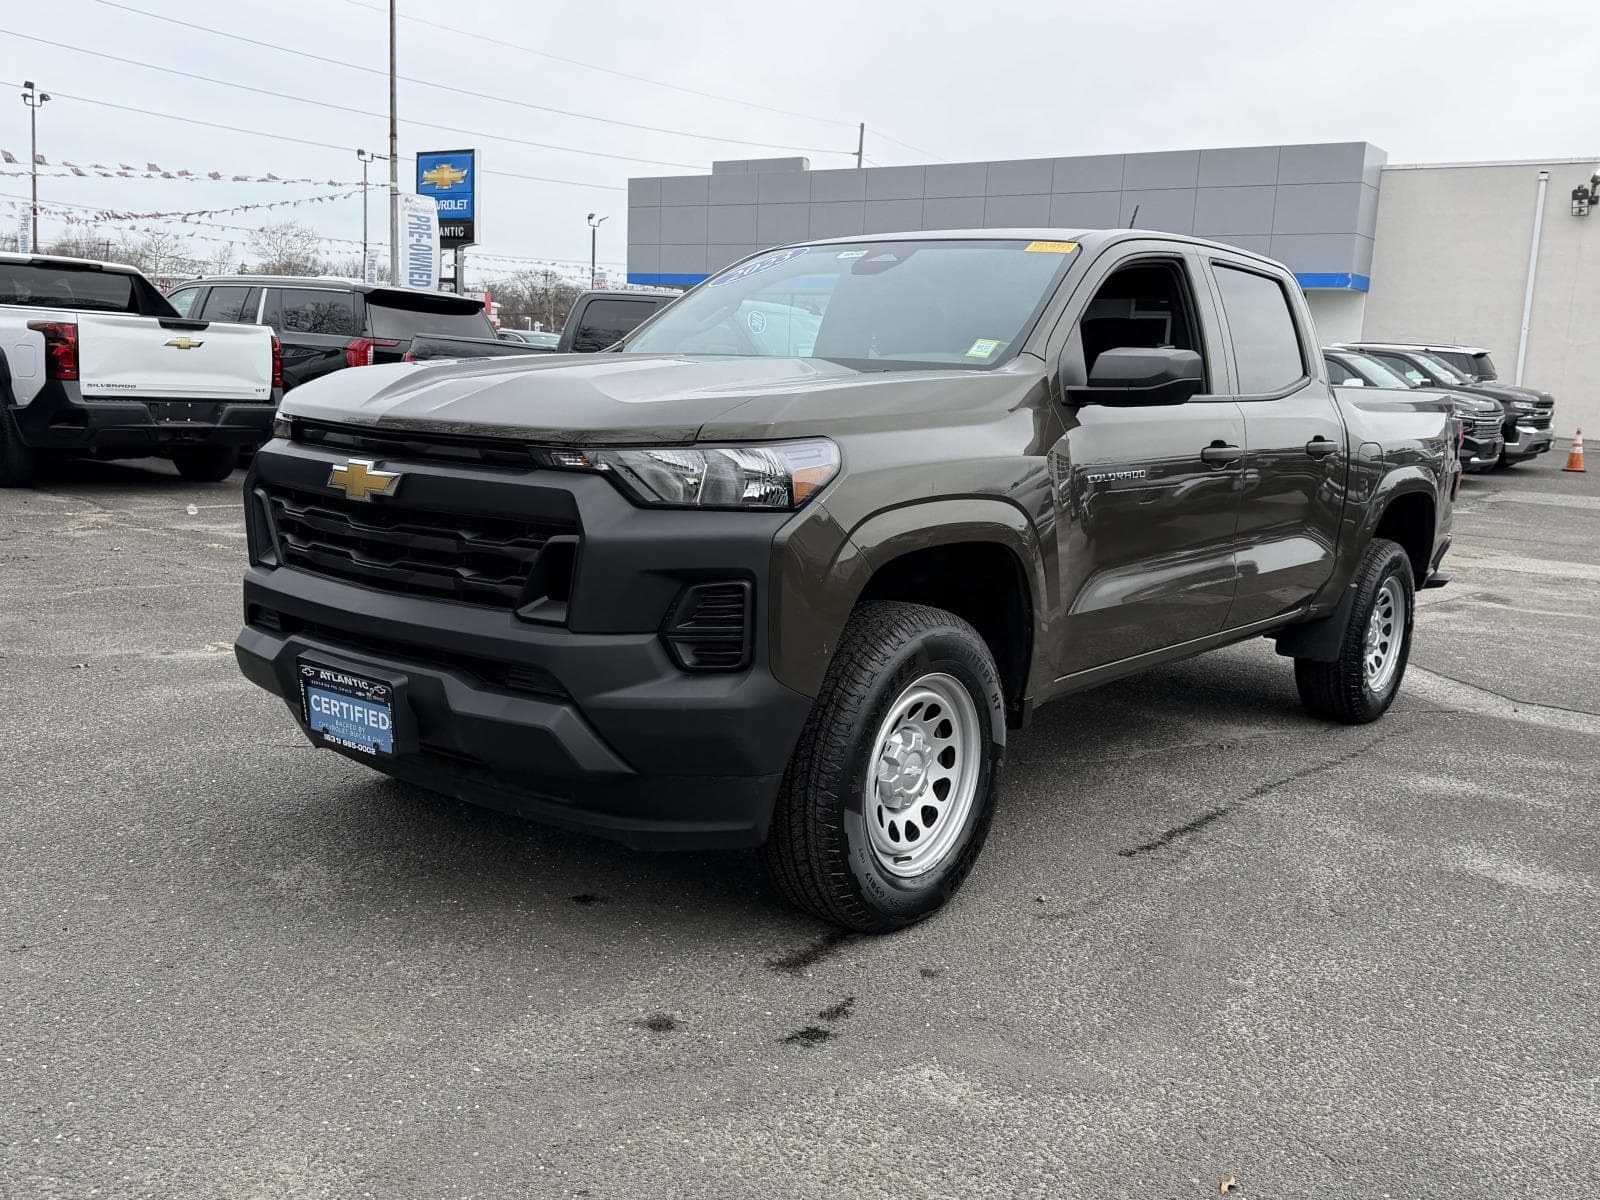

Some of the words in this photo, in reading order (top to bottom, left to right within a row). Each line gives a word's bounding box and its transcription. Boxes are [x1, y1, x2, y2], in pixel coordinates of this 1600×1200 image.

[435, 199, 468, 210] VROLET
[439, 226, 465, 237] ANTIC
[408, 213, 433, 287] PRE-OWNED
[1087, 469, 1146, 483] COLORADO
[319, 671, 369, 690] ATLANTIC
[310, 694, 390, 730] CERTIFIED
[335, 719, 357, 731] BACKED
[358, 726, 366, 734] BY
[350, 731, 366, 740] BUICK
